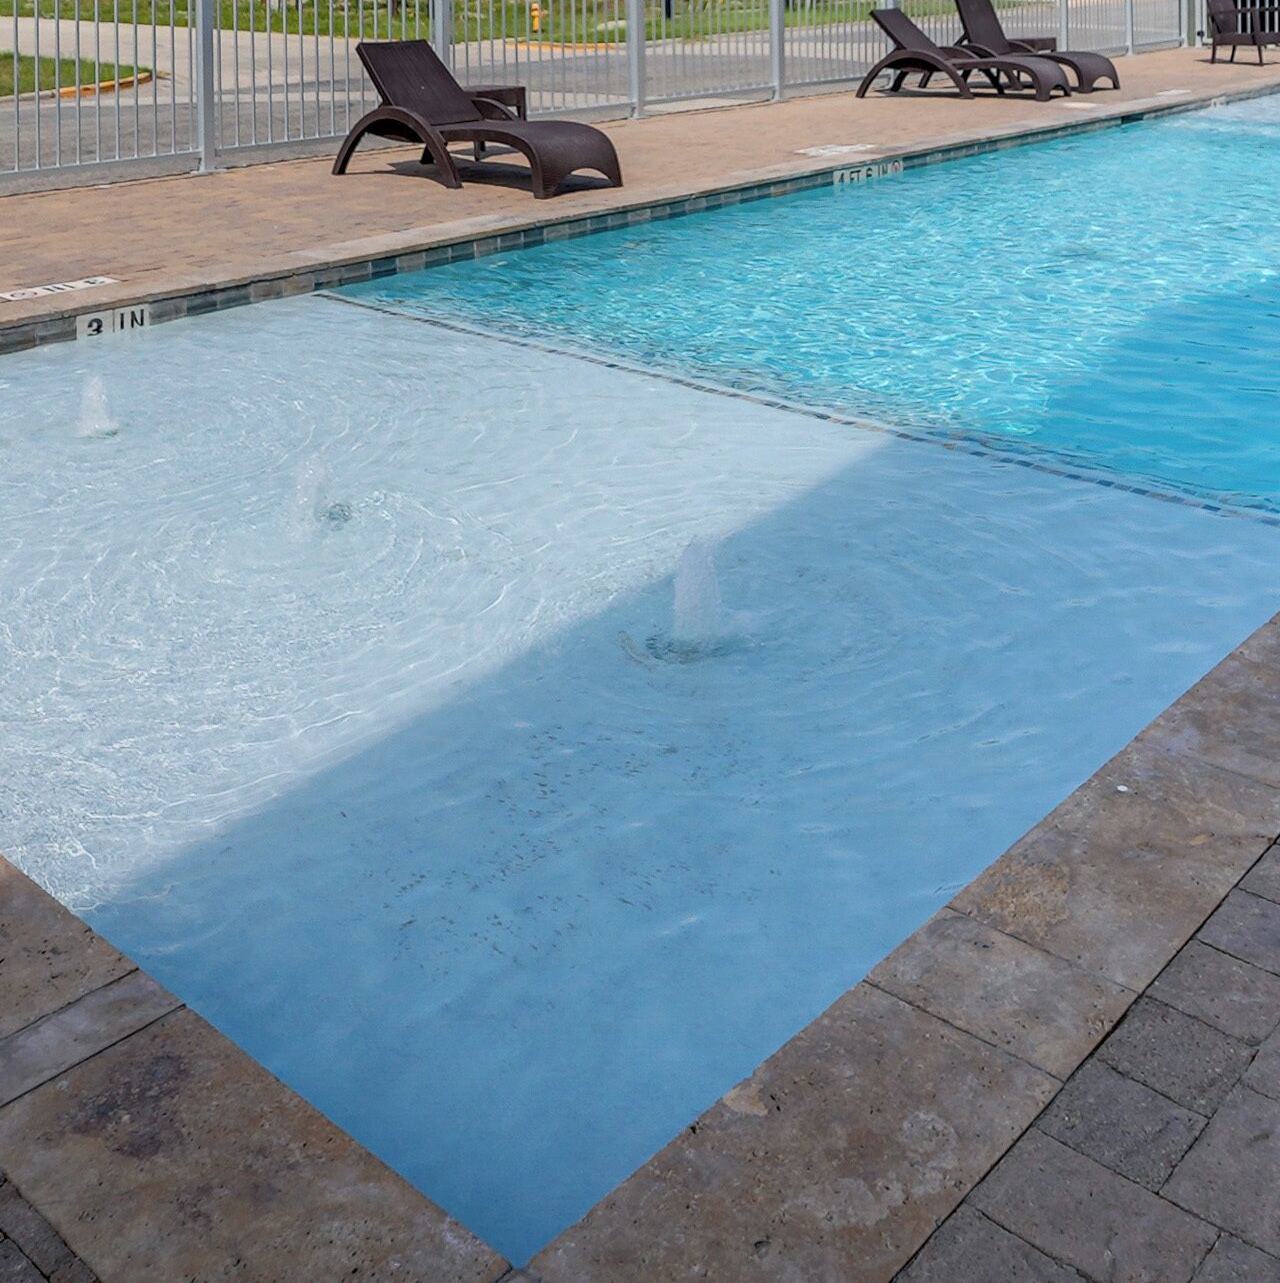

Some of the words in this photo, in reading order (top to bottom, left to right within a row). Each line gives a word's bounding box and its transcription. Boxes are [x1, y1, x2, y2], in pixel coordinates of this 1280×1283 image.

[850, 170, 861, 183] FT
[87, 318, 104, 337] 3
[120, 309, 145, 330] IN
